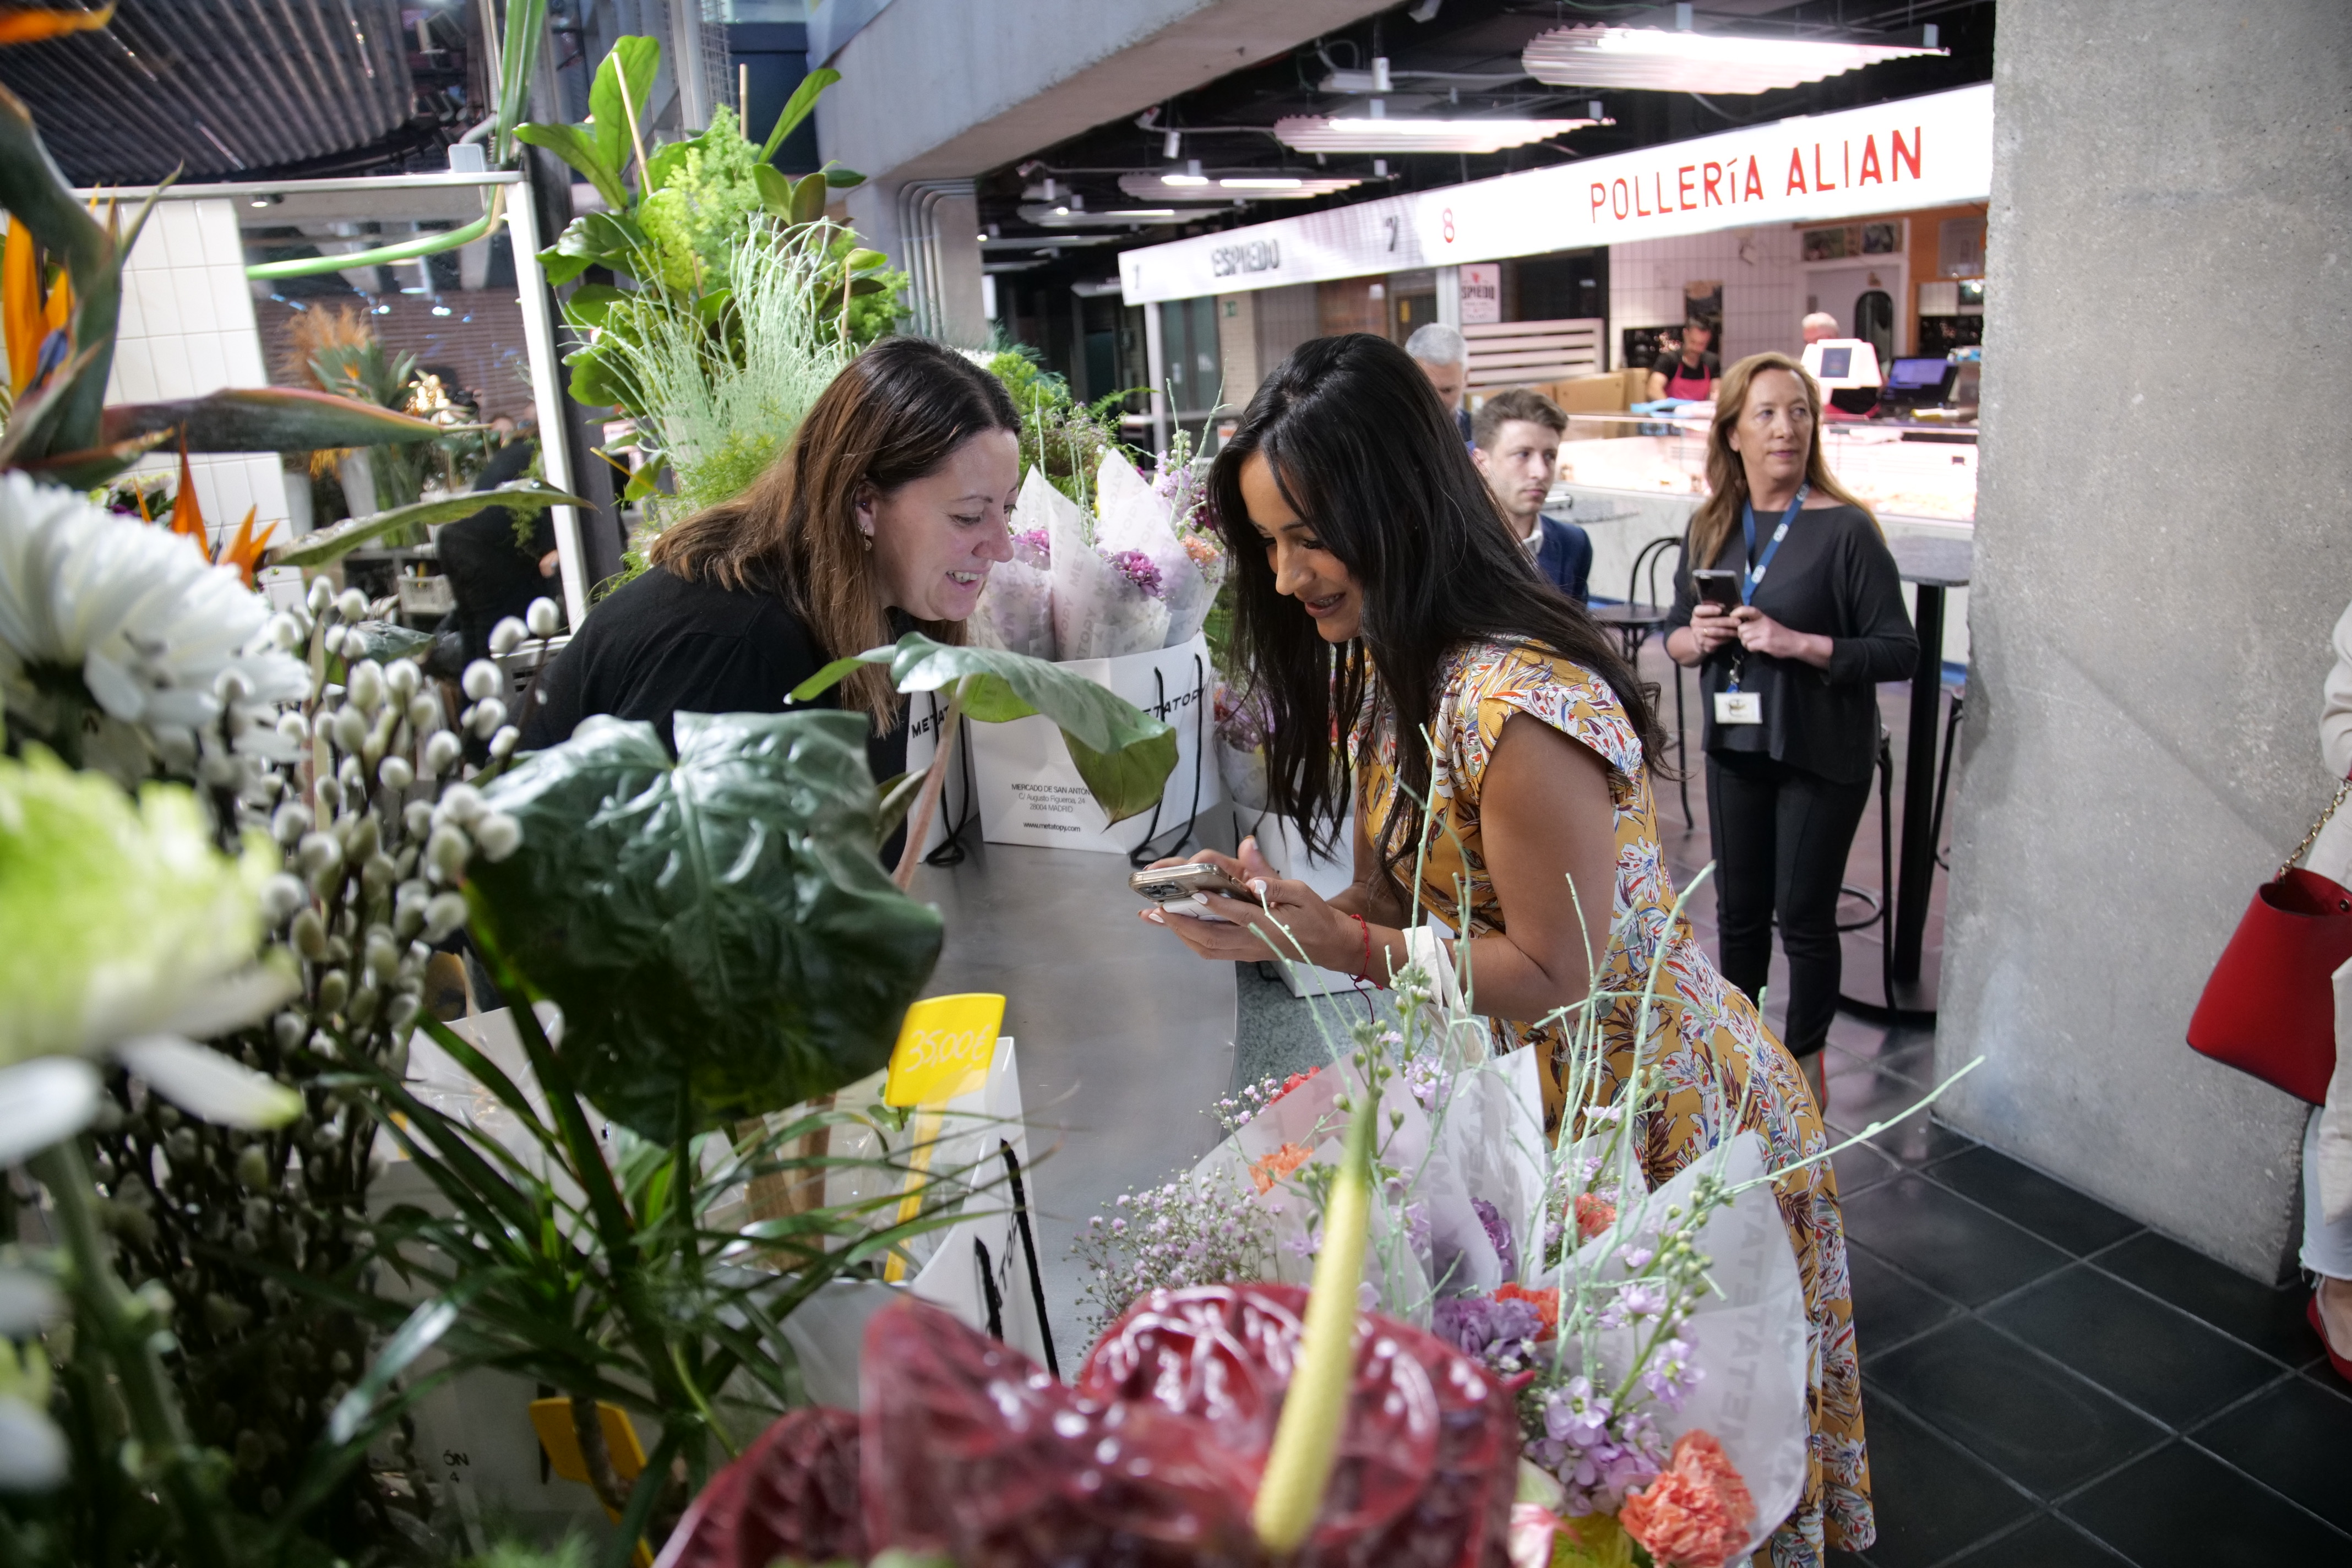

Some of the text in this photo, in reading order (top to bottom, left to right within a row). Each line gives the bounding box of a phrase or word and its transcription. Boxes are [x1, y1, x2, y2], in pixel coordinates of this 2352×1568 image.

[1786, 126, 1920, 196] ALIAN
[1443, 208, 1455, 243] 8
[1011, 783, 1042, 792] MERCADO
[1068, 787, 1090, 795] ANTÓN
[1026, 793, 1049, 802] Augusto
[1050, 795, 1076, 804] Figueroa,
[1048, 804, 1073, 813] MADRID
[1023, 822, 1080, 832] www.metatopy.com
